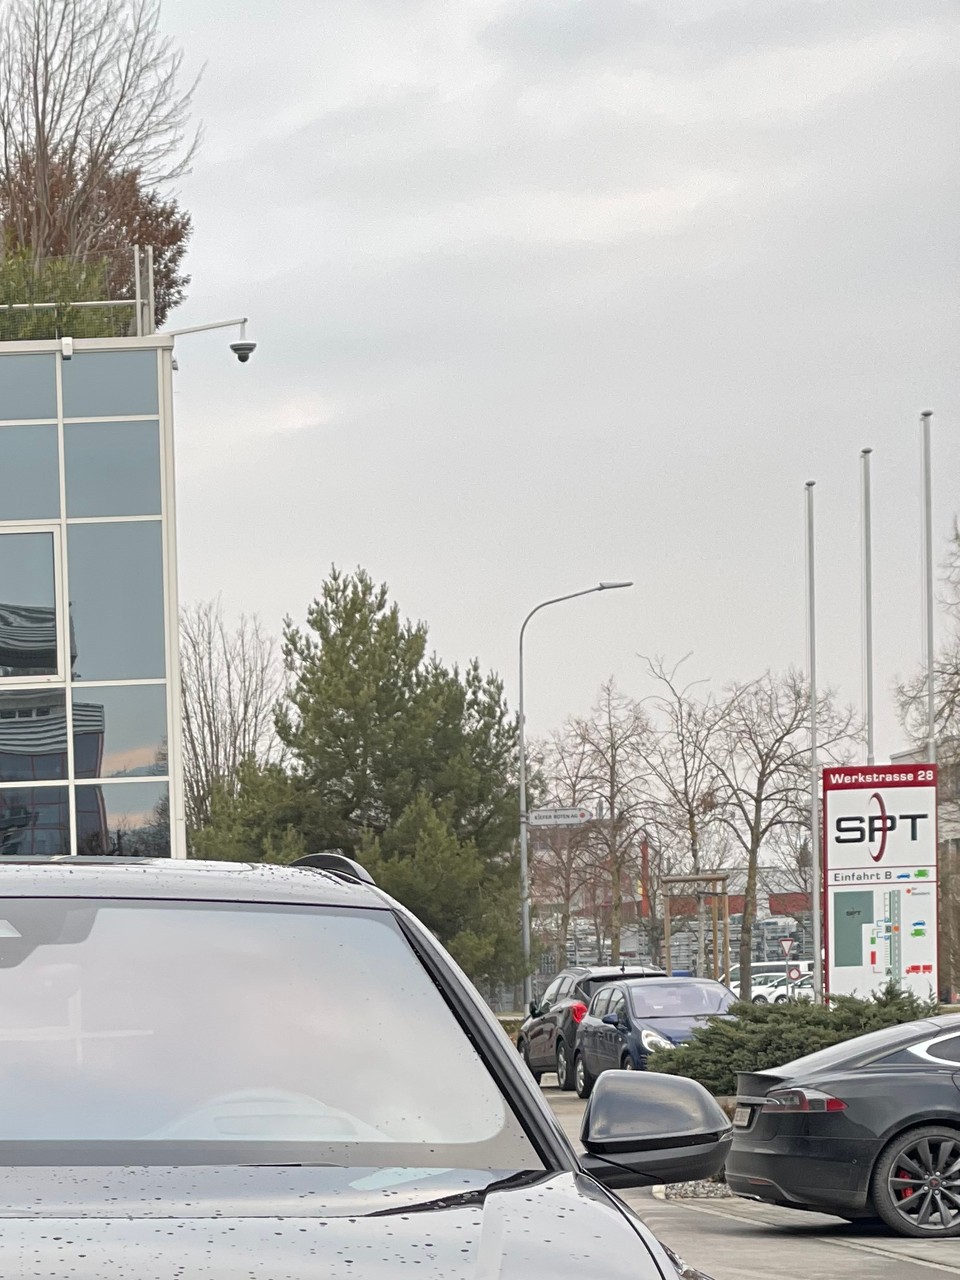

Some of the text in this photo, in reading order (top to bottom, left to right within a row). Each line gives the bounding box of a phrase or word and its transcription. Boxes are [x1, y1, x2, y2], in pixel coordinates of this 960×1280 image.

[830, 770, 934, 784] Werkstrasse 28
[834, 814, 929, 844] SPT
[834, 871, 892, 882] Einfahrt B
